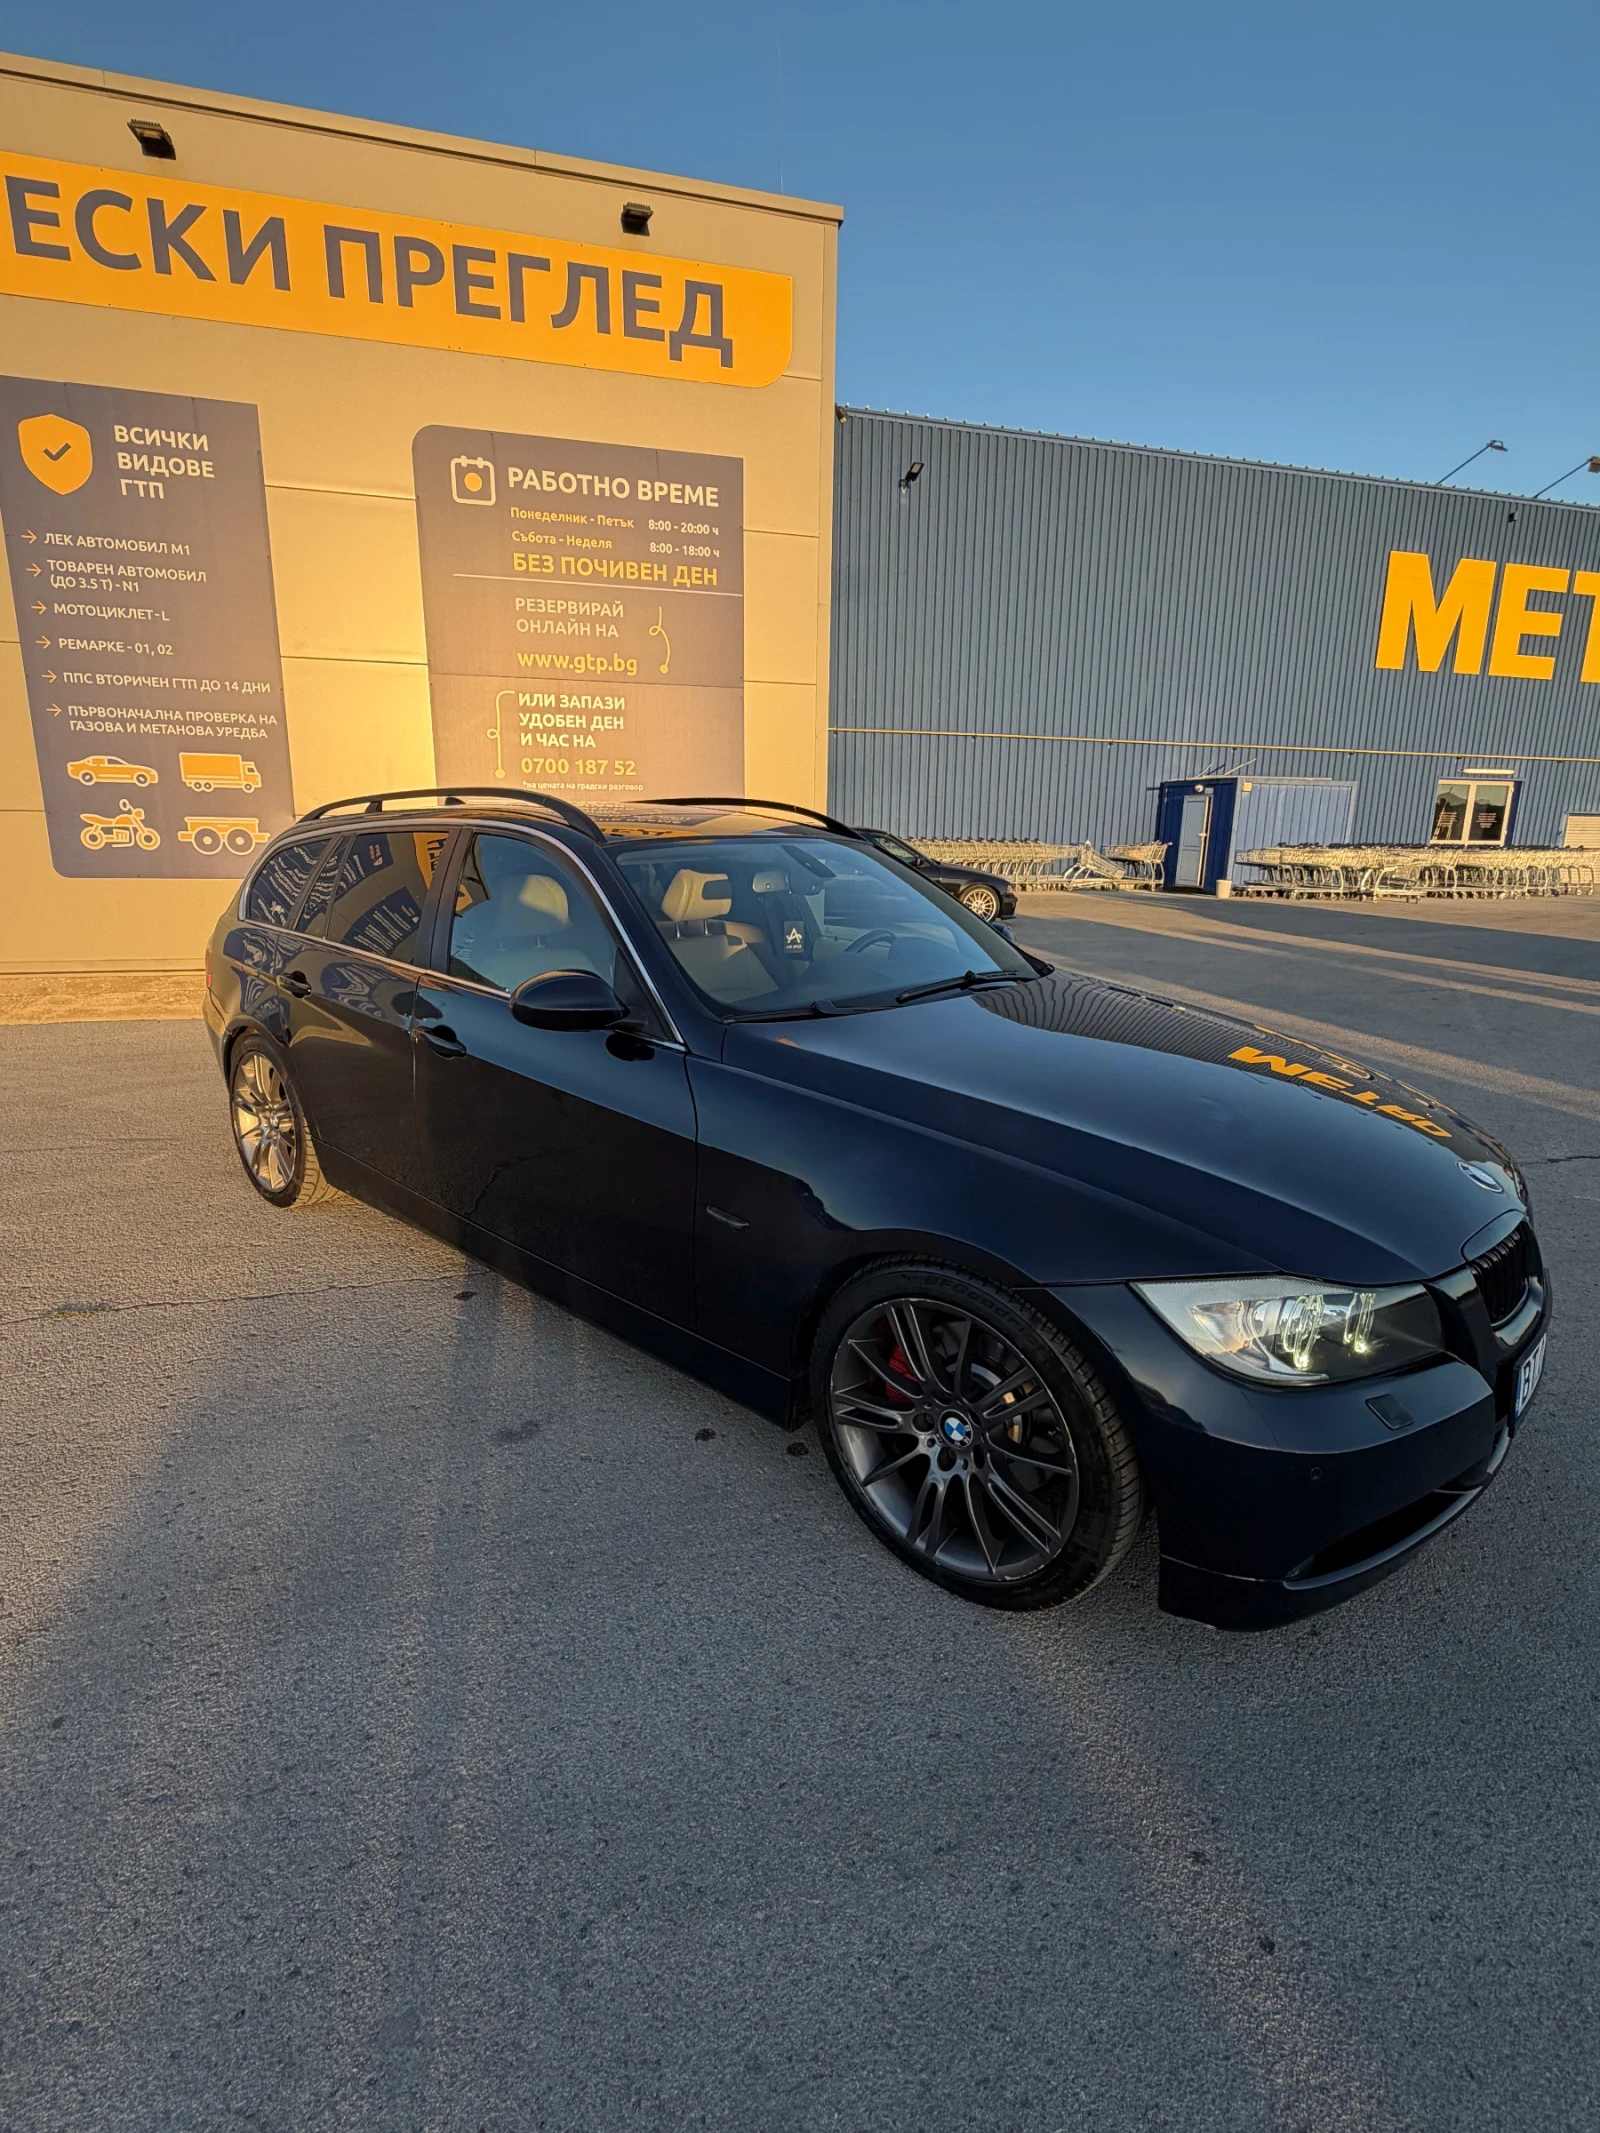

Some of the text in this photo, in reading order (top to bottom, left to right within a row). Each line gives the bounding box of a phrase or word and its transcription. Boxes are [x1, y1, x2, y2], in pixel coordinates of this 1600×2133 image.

[5, 175, 734, 369] ЕСКИ ПРЕГЛЕД
[114, 425, 208, 451] ВСИЧКИ
[117, 452, 215, 478] ВИДОВЕ
[120, 478, 164, 499] ГТП
[508, 467, 719, 507] РАБОТНО ВРЕМЕ
[510, 507, 587, 525] Понеделник
[597, 515, 635, 529] Петък
[648, 519, 671, 532] 8:00
[680, 521, 710, 535] 20:00
[712, 525, 719, 536] ч
[44, 533, 73, 546] ЛЕК
[76, 535, 168, 554] АВТОМОБИЛ
[512, 530, 556, 544] Събота
[566, 535, 612, 550] Неделя
[649, 542, 672, 554] 8:00
[682, 544, 711, 557] 18:00
[713, 548, 720, 558] ч
[47, 559, 207, 582] ТОВАРЕН АВТОМОБИЛ
[513, 552, 718, 588] БЕЗ ПОЧИВЕН ДЕН
[50, 574, 76, 589] (ДО
[79, 577, 98, 589] 3.5
[100, 578, 113, 592] Т)
[123, 581, 139, 592] N1
[515, 597, 624, 618] РЕЗЕРВИРАЙ
[516, 618, 619, 638] ОНЛАЙН НА
[58, 638, 125, 653] РЕМАРКЕ
[517, 652, 638, 676] www.gtp.bg
[63, 672, 271, 694] ППС ВТОРИЧЕН ГТП ДО 14 ДНИ
[518, 692, 625, 710] ИЛИ ЗАПАЗИ
[67, 705, 278, 725] ПЪРВОНАЧАЛНА ПРОВЕРКА НА
[519, 712, 624, 731] УДОБЕН ДЕН
[70, 720, 268, 740] ГАЗОВА И МЕТАНОВА УРЕДБА
[520, 732, 596, 748] И ЧАС НА
[521, 757, 636, 776] 0700 187 52
[538, 782, 564, 790] цената
[577, 783, 607, 791] градски
